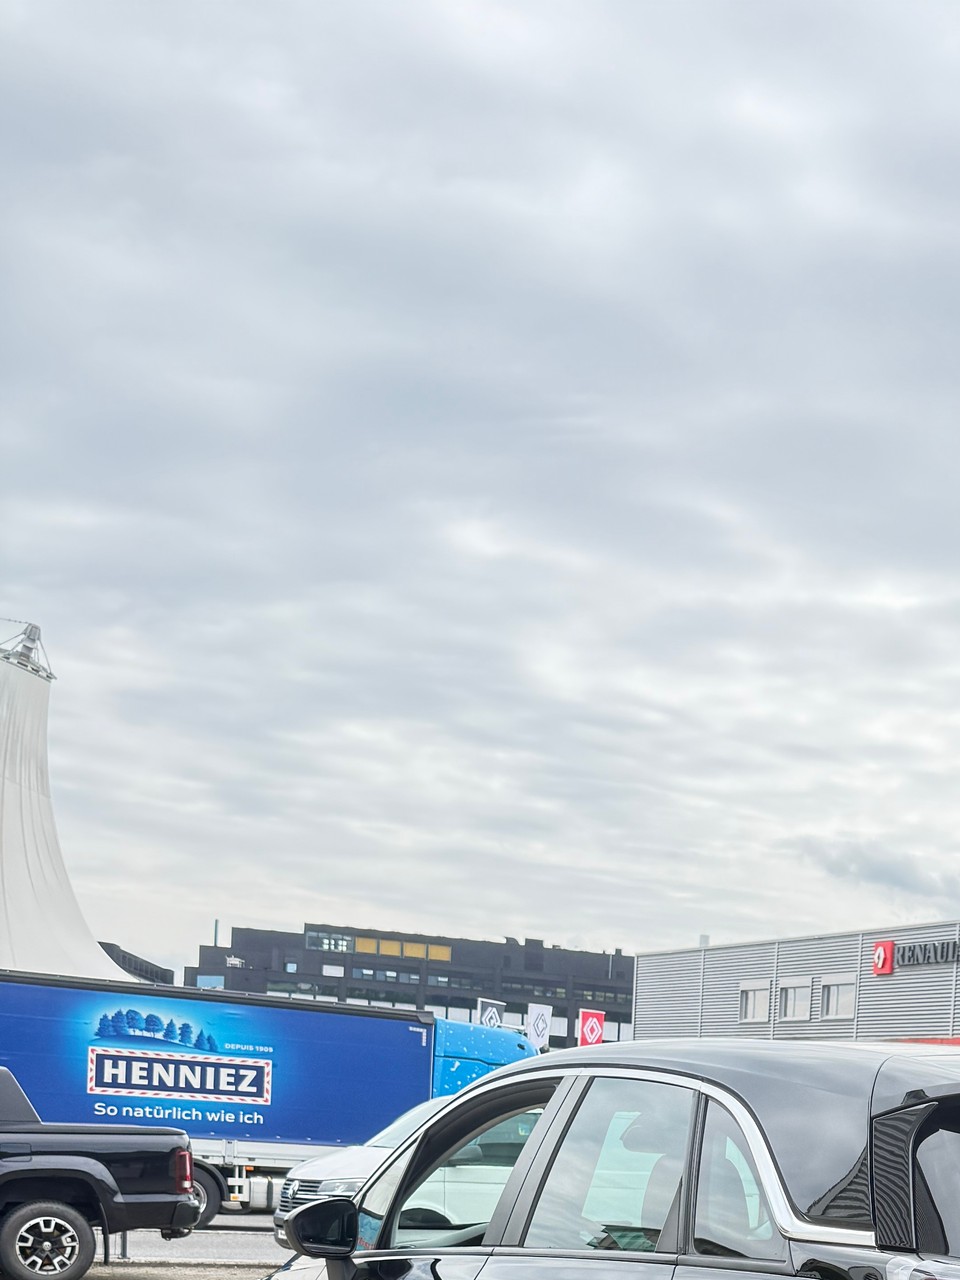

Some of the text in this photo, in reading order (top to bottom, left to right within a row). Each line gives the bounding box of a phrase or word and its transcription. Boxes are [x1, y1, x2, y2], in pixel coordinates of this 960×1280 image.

[224, 1043, 254, 1052] DEPUIS
[103, 1059, 258, 1093] HENNIEZ
[94, 1103, 264, 1124] So natürlich wie ich
